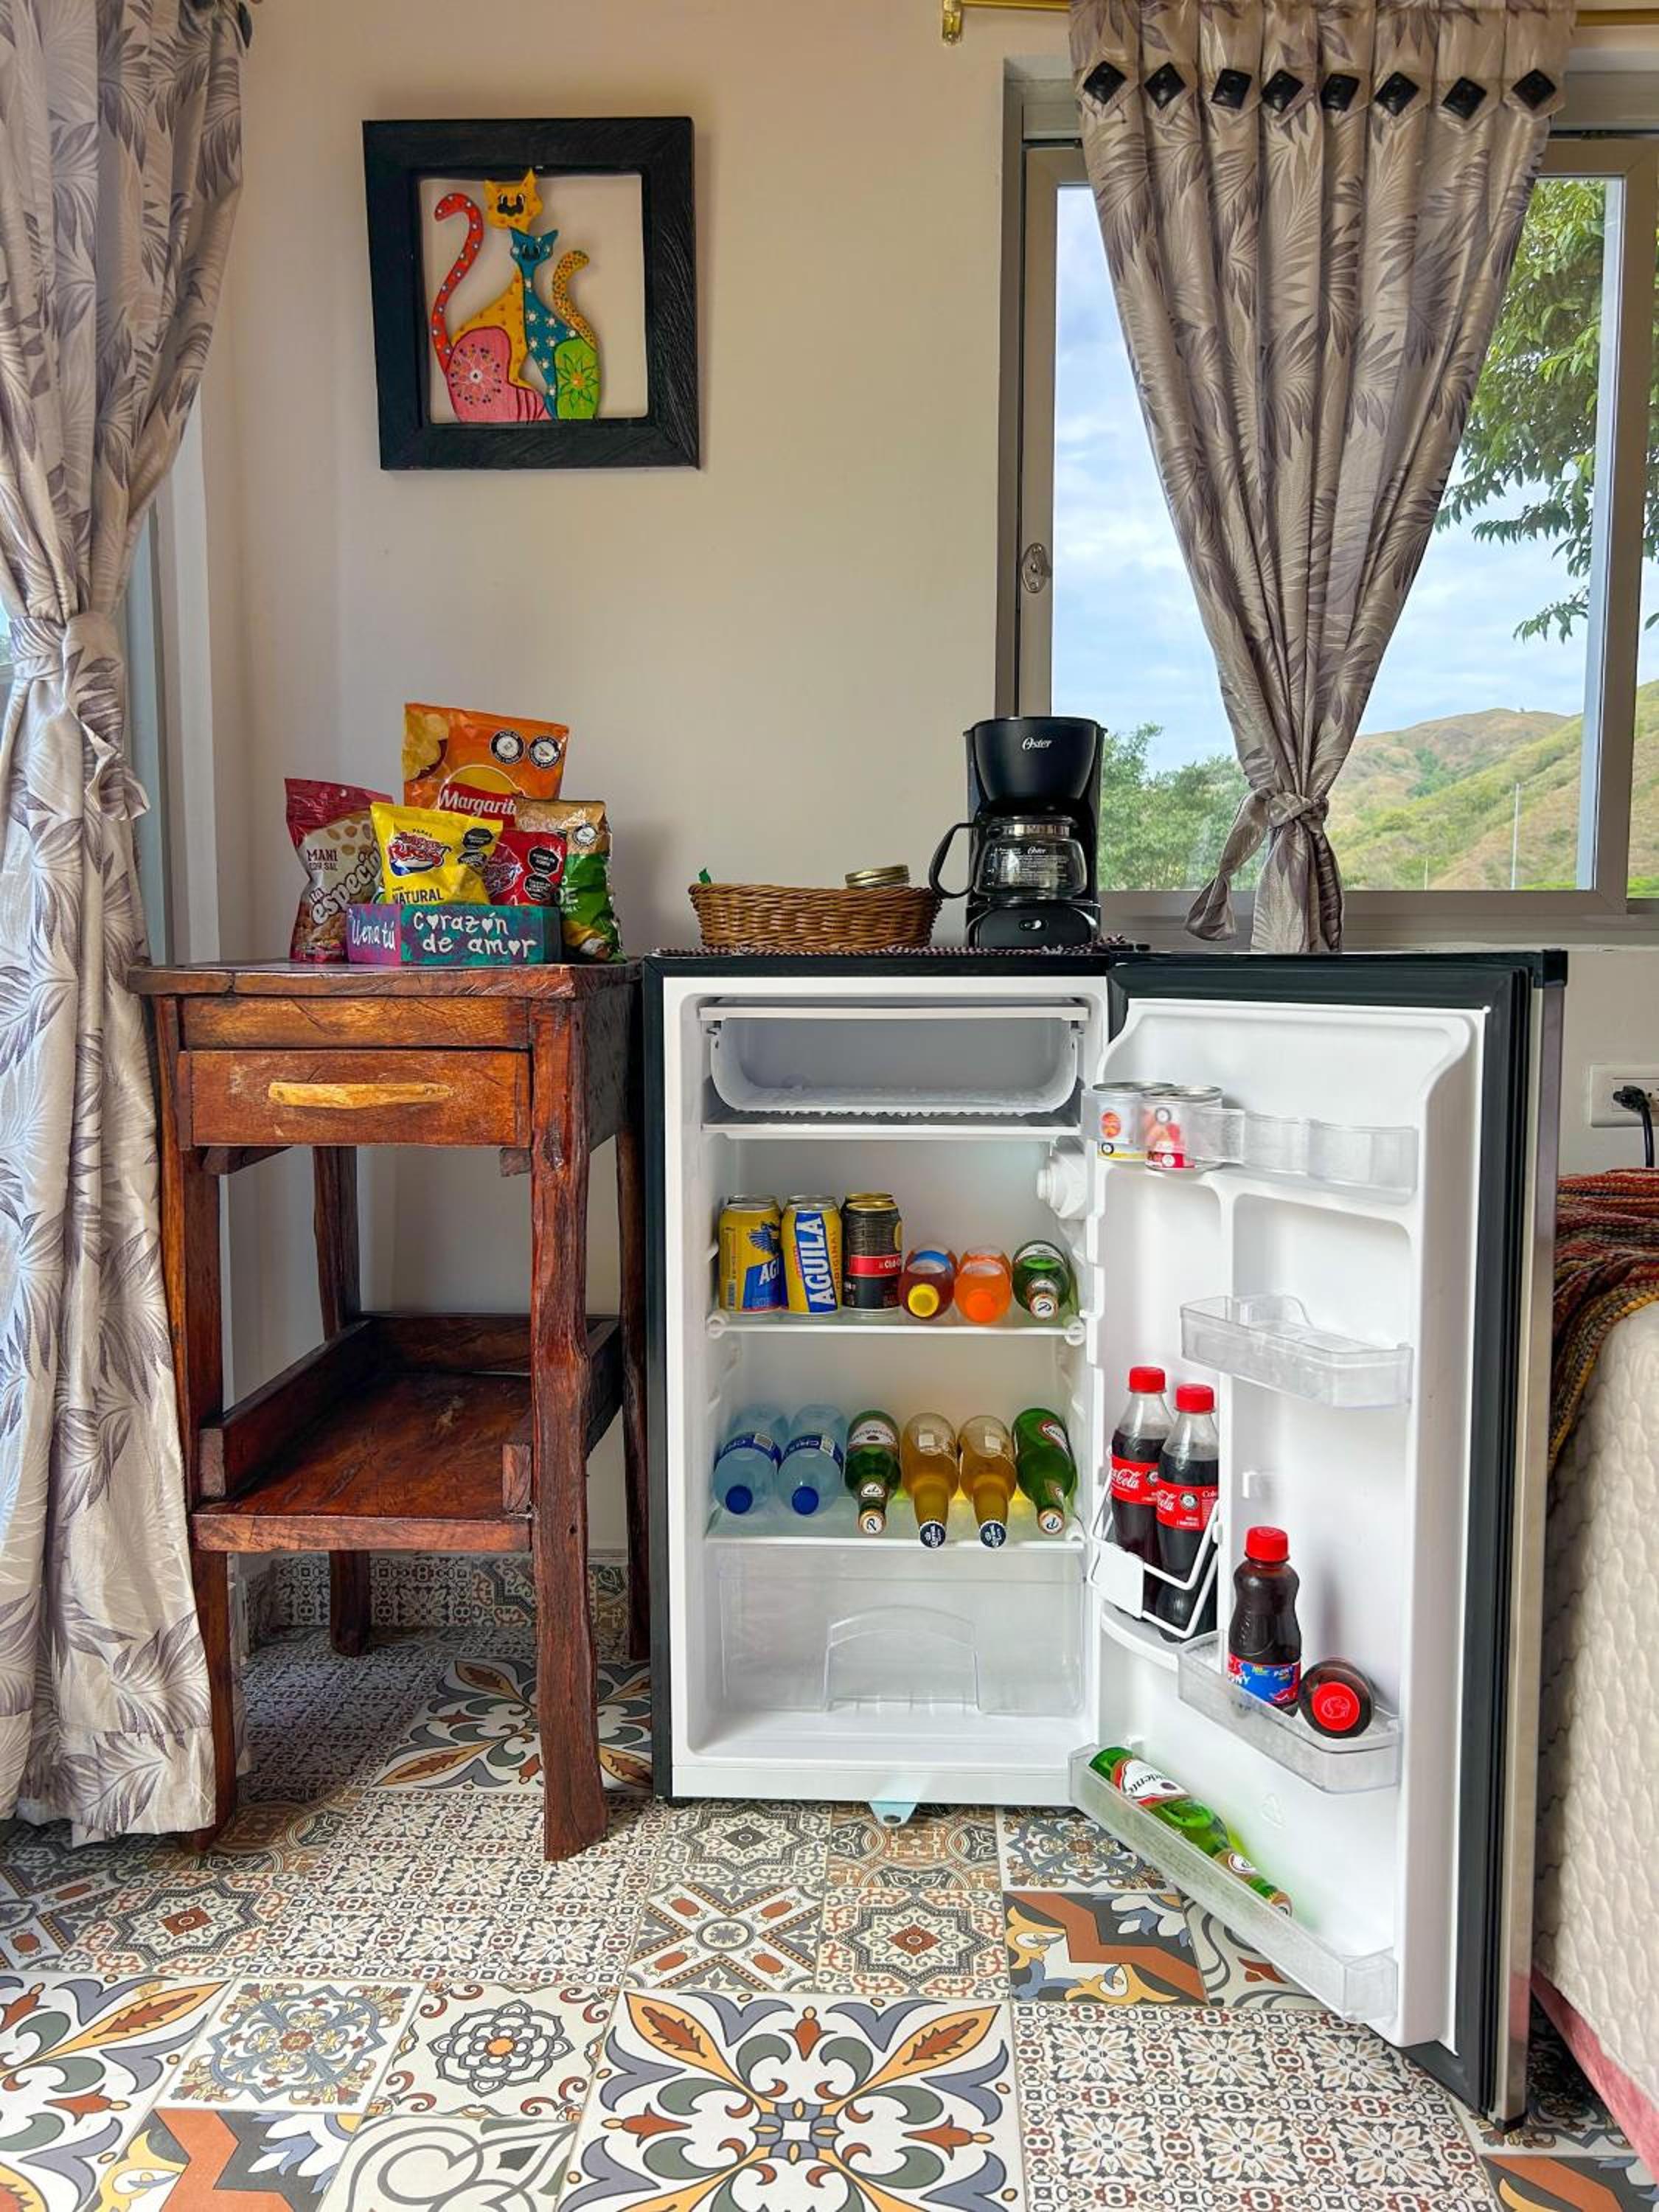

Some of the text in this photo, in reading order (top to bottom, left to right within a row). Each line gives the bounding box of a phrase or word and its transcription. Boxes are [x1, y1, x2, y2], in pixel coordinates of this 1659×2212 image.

[1022, 737, 1052, 751] Oster
[392, 888, 444, 905] NATURAL
[422, 933, 537, 958] de amor
[796, 1216, 837, 1306] AGUILA
